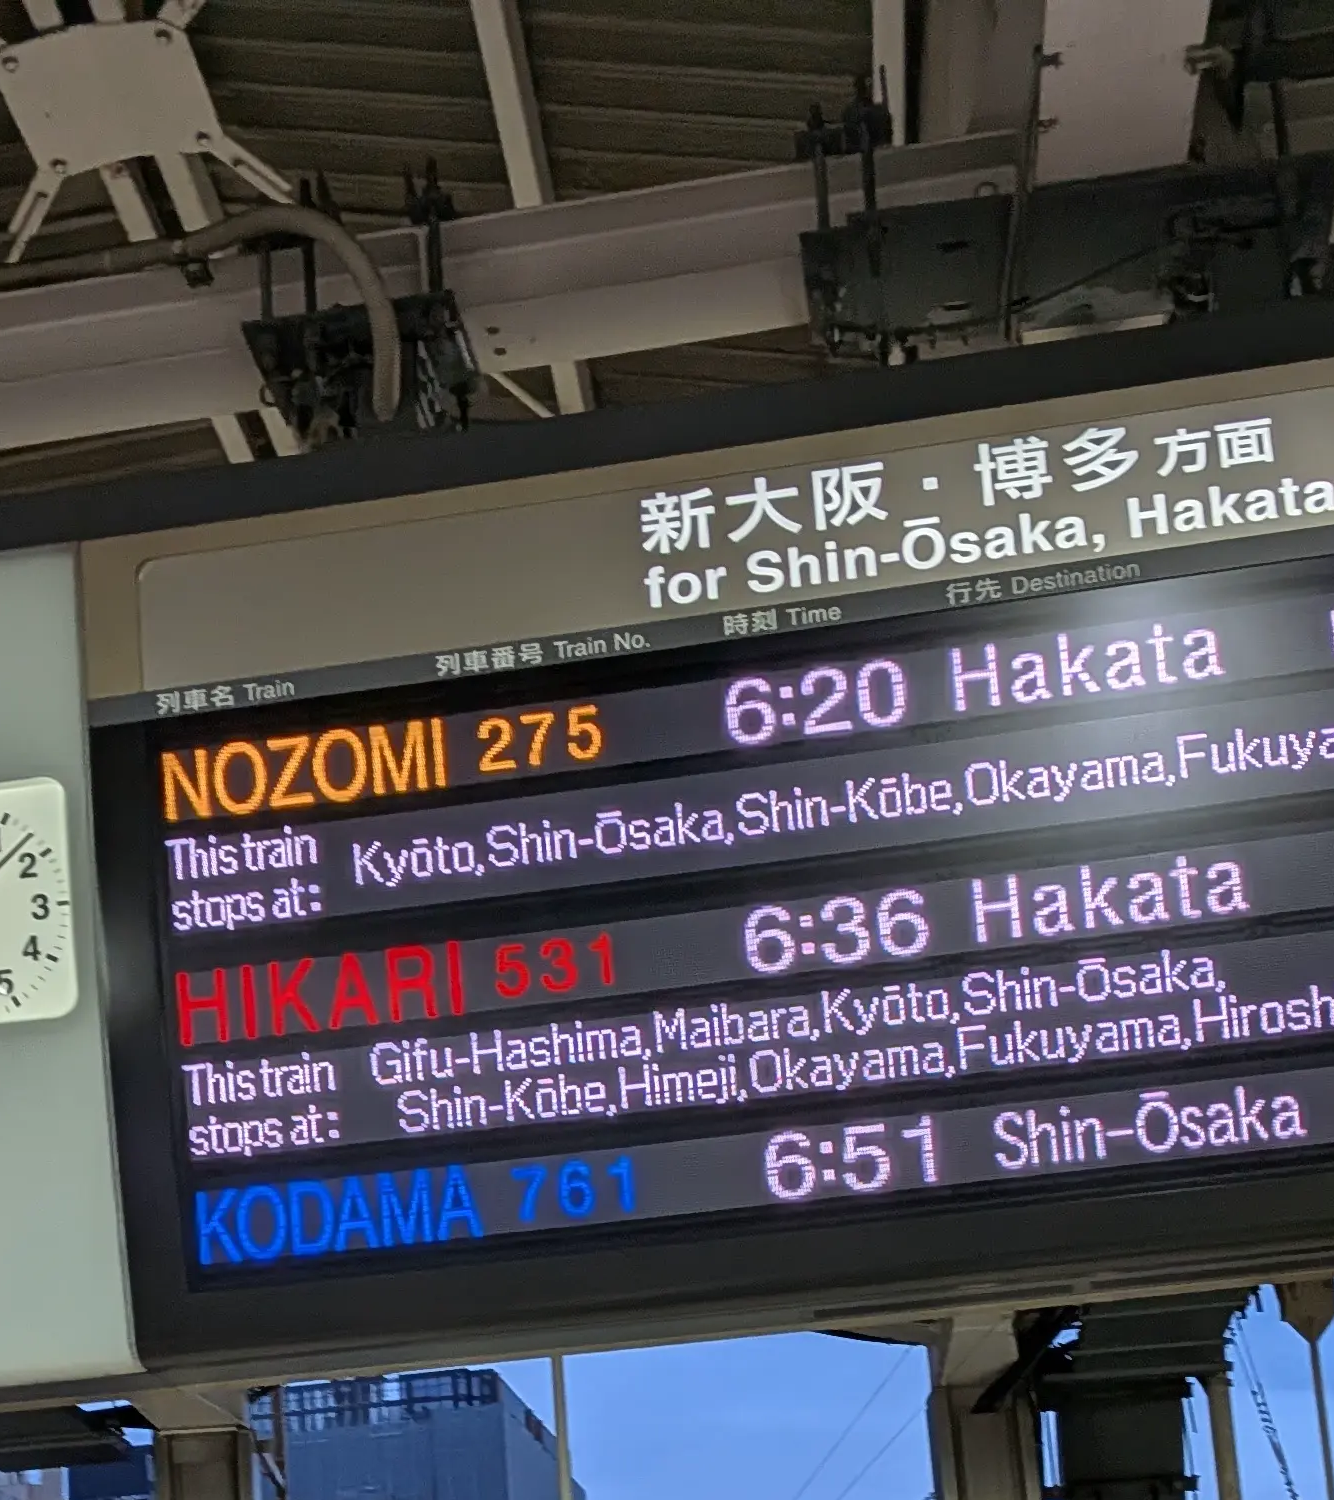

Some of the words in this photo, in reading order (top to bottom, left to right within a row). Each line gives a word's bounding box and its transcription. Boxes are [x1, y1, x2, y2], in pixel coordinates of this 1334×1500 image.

[643, 561, 727, 609] for
[746, 510, 1107, 594] Shin-Ōsaka,
[155, 685, 236, 716] 列車名
[243, 679, 296, 703] Train
[435, 642, 544, 678] 列車番号
[554, 636, 607, 663] Train
[613, 632, 651, 654] No.
[722, 607, 778, 637] 時刻
[785, 601, 842, 627] Time
[944, 574, 1002, 606] 行先
[1011, 559, 1142, 597] Destination
[160, 716, 448, 823] NOZOMI
[476, 704, 604, 773] 275
[723, 657, 907, 746] 6:20
[951, 621, 1226, 713] Hakata
[18, 852, 39, 879] 2
[30, 893, 50, 920] 3
[22, 935, 41, 962] 4
[176, 940, 465, 1048] HIKARI
[495, 932, 615, 998] 531
[745, 886, 930, 975] 6:36
[971, 855, 1250, 945] Hakata
[195, 1164, 484, 1266] KODAMA
[509, 1155, 635, 1222] 761
[763, 1113, 940, 1200] 6:51
[992, 1085, 1307, 1172] Shin-Ōsaka
